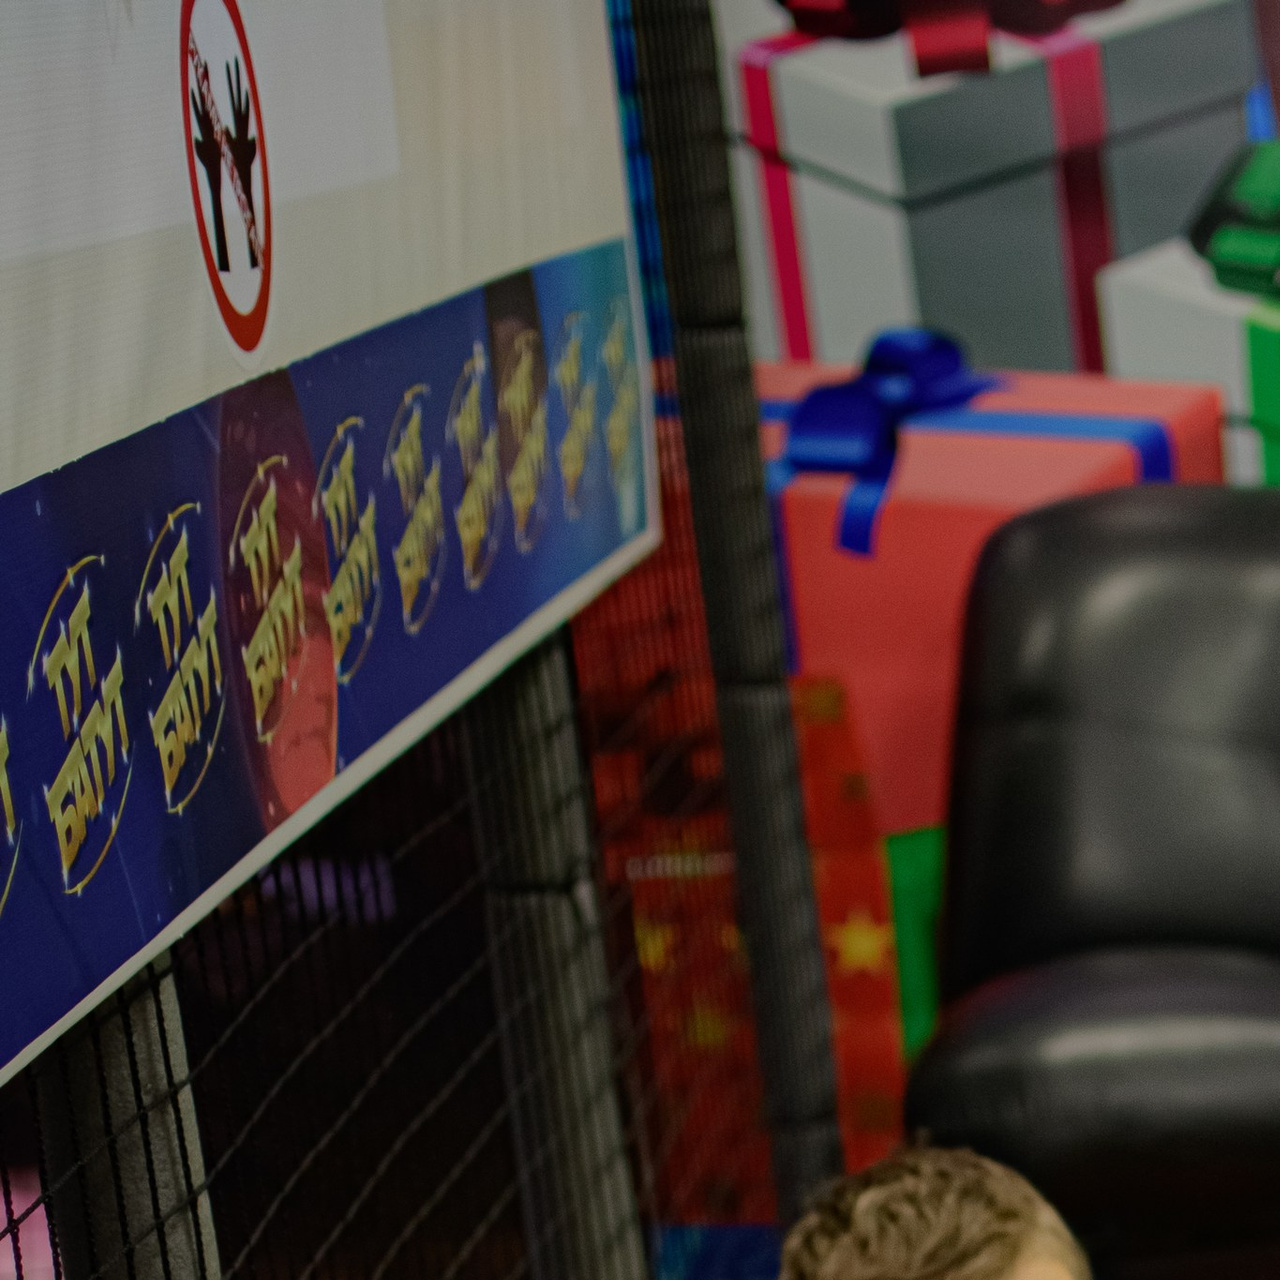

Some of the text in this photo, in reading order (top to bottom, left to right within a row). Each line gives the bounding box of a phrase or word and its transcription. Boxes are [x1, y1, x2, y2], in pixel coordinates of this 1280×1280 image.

[44, 584, 96, 741] ТУТ
[148, 530, 194, 671] ТУТ
[149, 588, 222, 795] БАТУТ
[46, 650, 129, 880] БАТУТ
